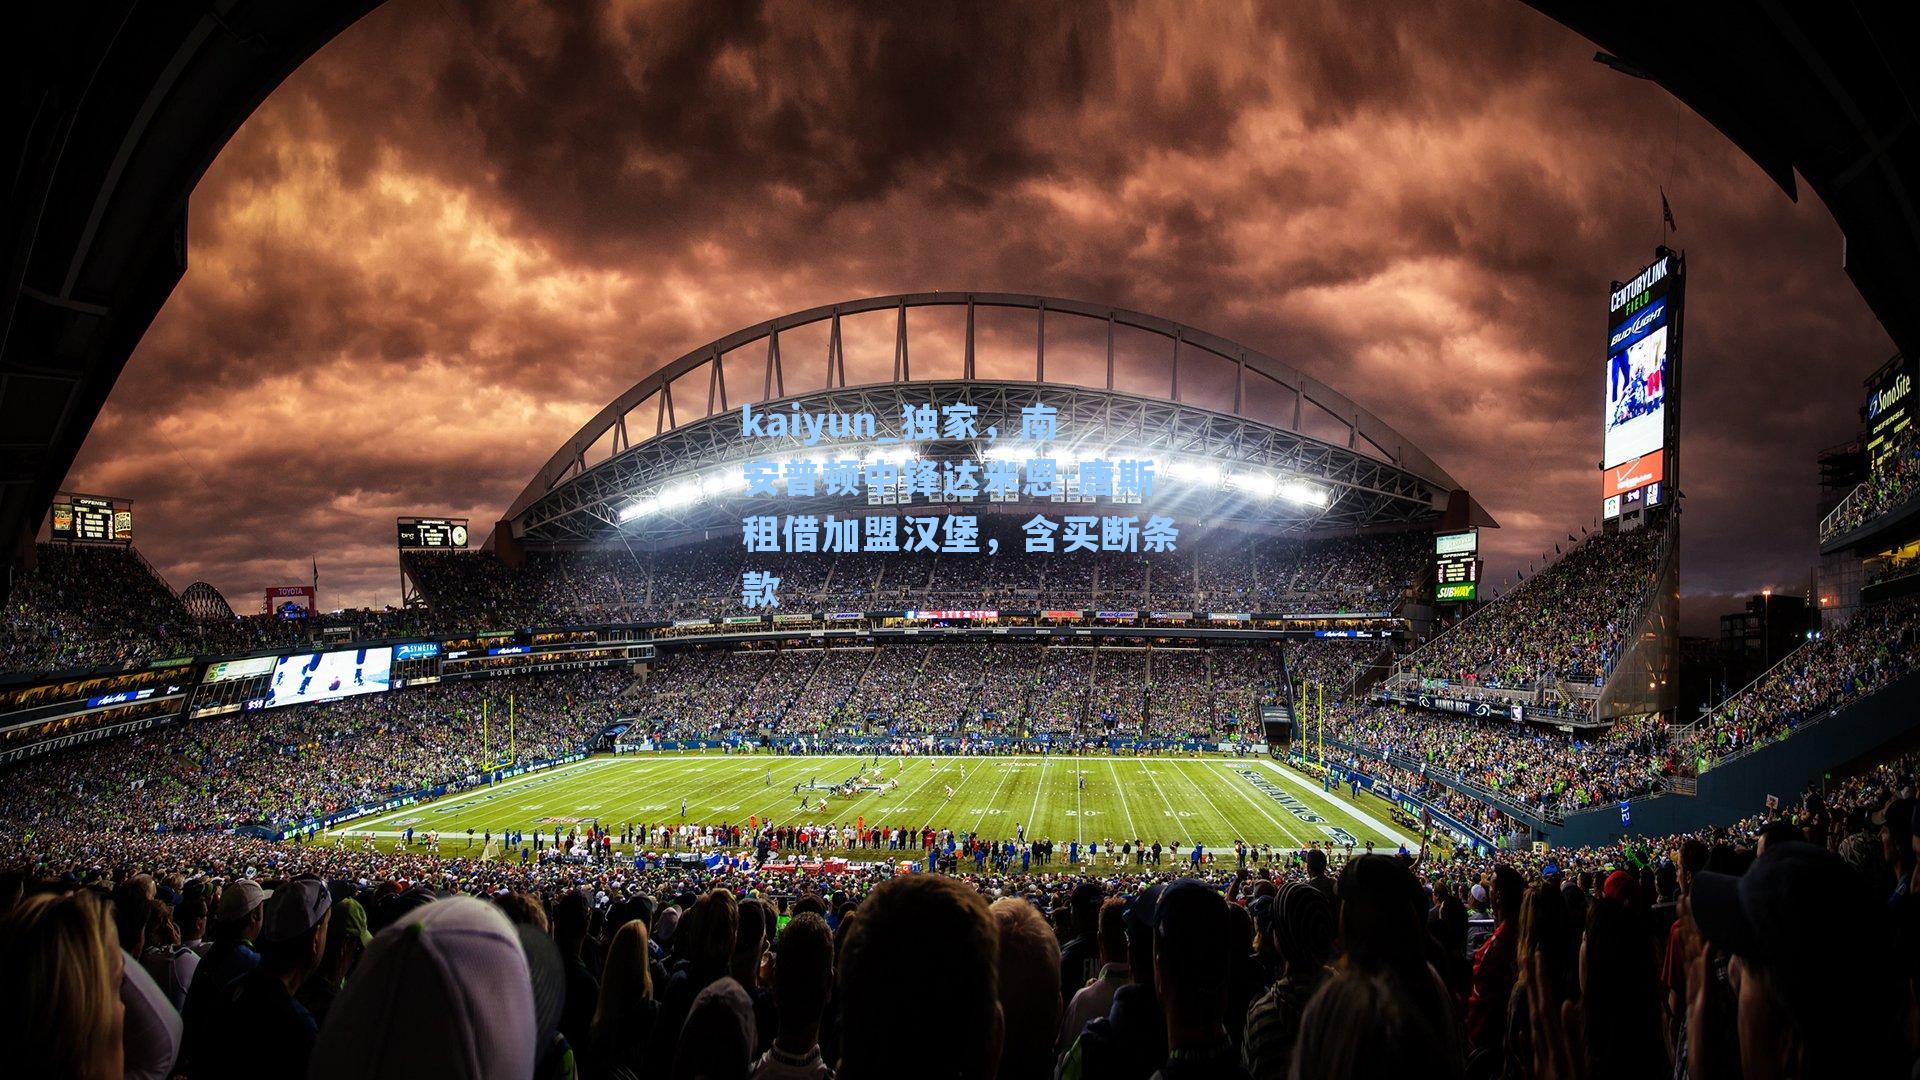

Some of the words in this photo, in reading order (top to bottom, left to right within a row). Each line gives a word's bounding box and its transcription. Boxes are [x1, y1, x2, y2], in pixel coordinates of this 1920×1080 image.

[1611, 256, 1668, 312] CENTURYLINK
[1626, 290, 1649, 316] FIELD
[1611, 327, 1631, 346] BUD
[1633, 305, 1664, 332] LIGHT
[1878, 373, 1911, 414] SonoSite
[1873, 407, 1904, 434] DEFENSE
[401, 532, 414, 540] bing
[278, 587, 303, 595] TOYOTA
[1437, 585, 1474, 598] SUBWAY
[410, 644, 438, 652] SYMETRA
[490, 668, 516, 677] HOME
[561, 662, 583, 670] 12TH
[589, 660, 609, 668] MAN
[9, 749, 24, 762] TO
[30, 728, 112, 756] CENTURYLINK
[118, 720, 153, 735] FIELD
[1233, 769, 1328, 823] SEAHAWKS
[1620, 806, 1630, 822] 12
